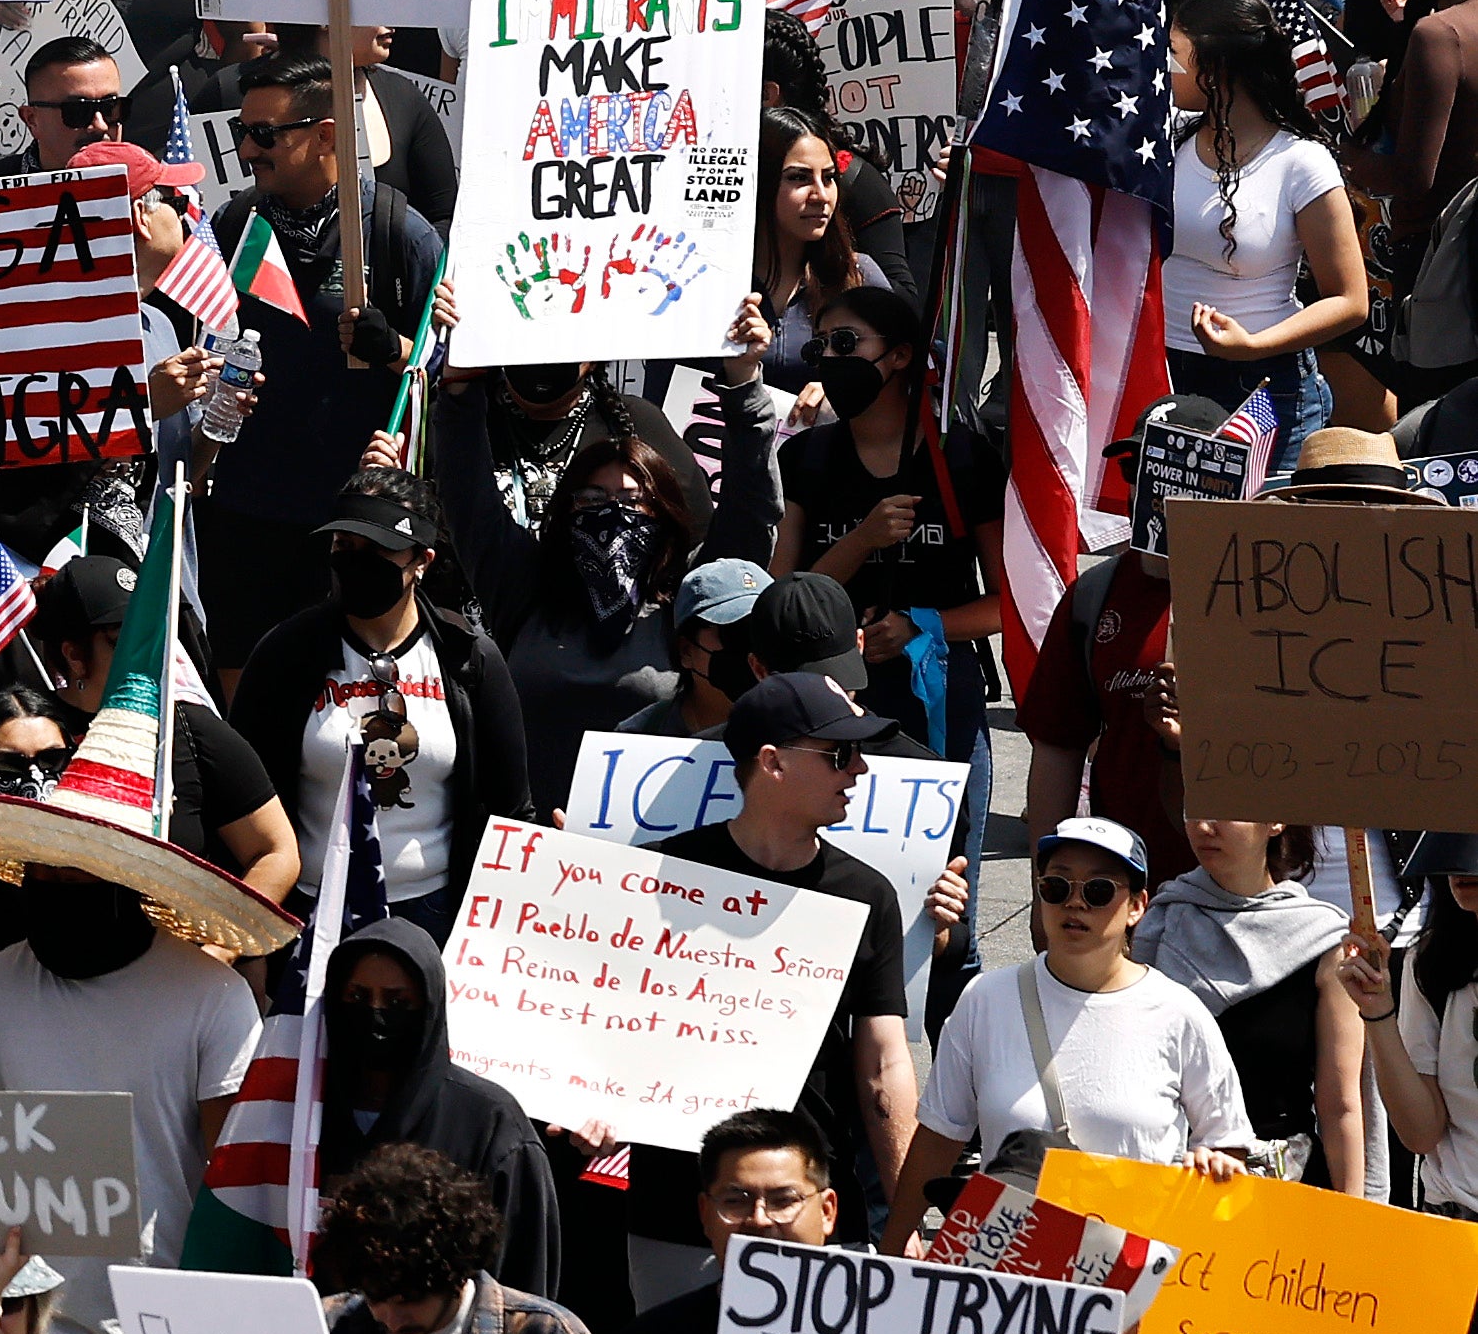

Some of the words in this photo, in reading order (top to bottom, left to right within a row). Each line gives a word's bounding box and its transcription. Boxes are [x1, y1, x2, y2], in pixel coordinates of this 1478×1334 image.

[539, 37, 668, 97] MAKE
[523, 90, 701, 160] AMERICA
[687, 154, 748, 169] ILLEGAL
[533, 155, 662, 219] GREAT
[683, 187, 742, 202] LAND
[686, 175, 744, 187] STOLEN
